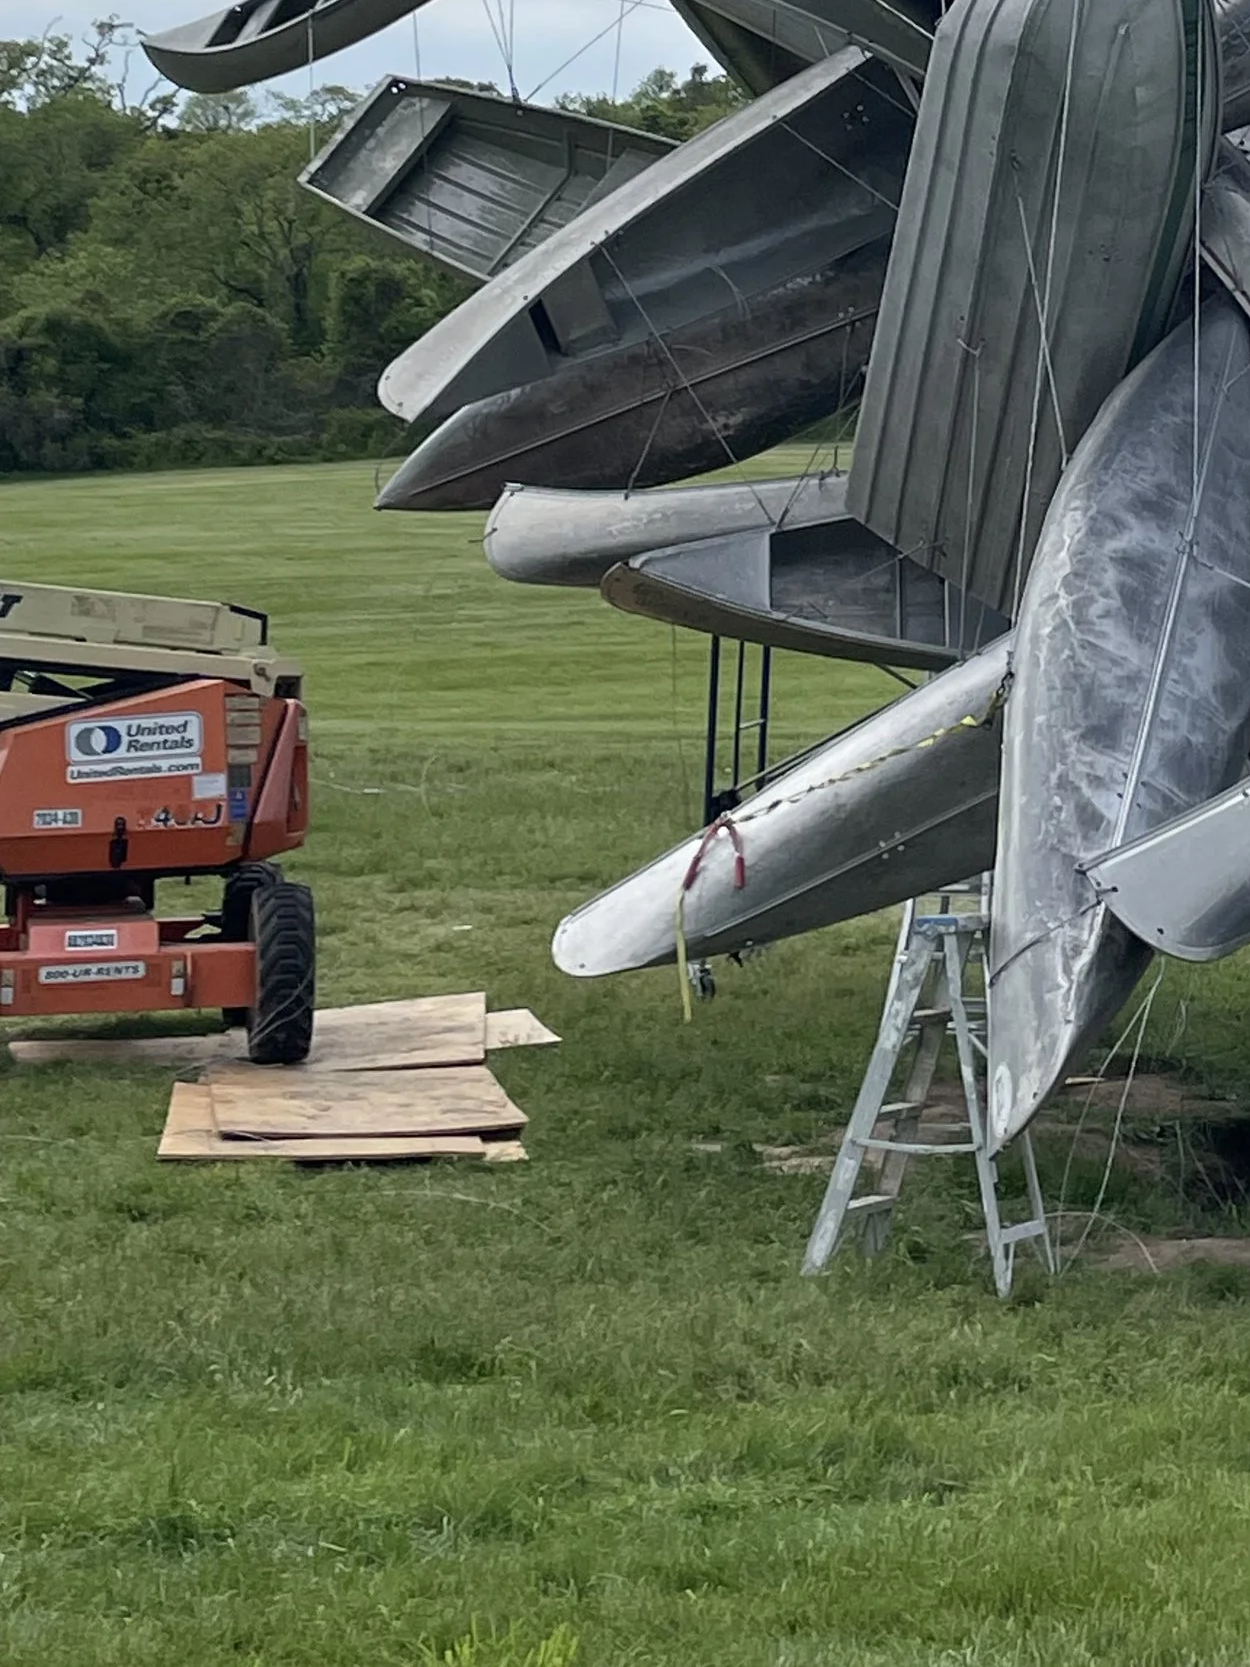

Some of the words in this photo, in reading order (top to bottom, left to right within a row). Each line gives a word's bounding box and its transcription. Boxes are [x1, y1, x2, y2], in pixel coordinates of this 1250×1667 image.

[126, 720, 189, 738] United
[126, 736, 195, 753] Rentals
[44, 965, 140, 980] 800-UR-RENTS
